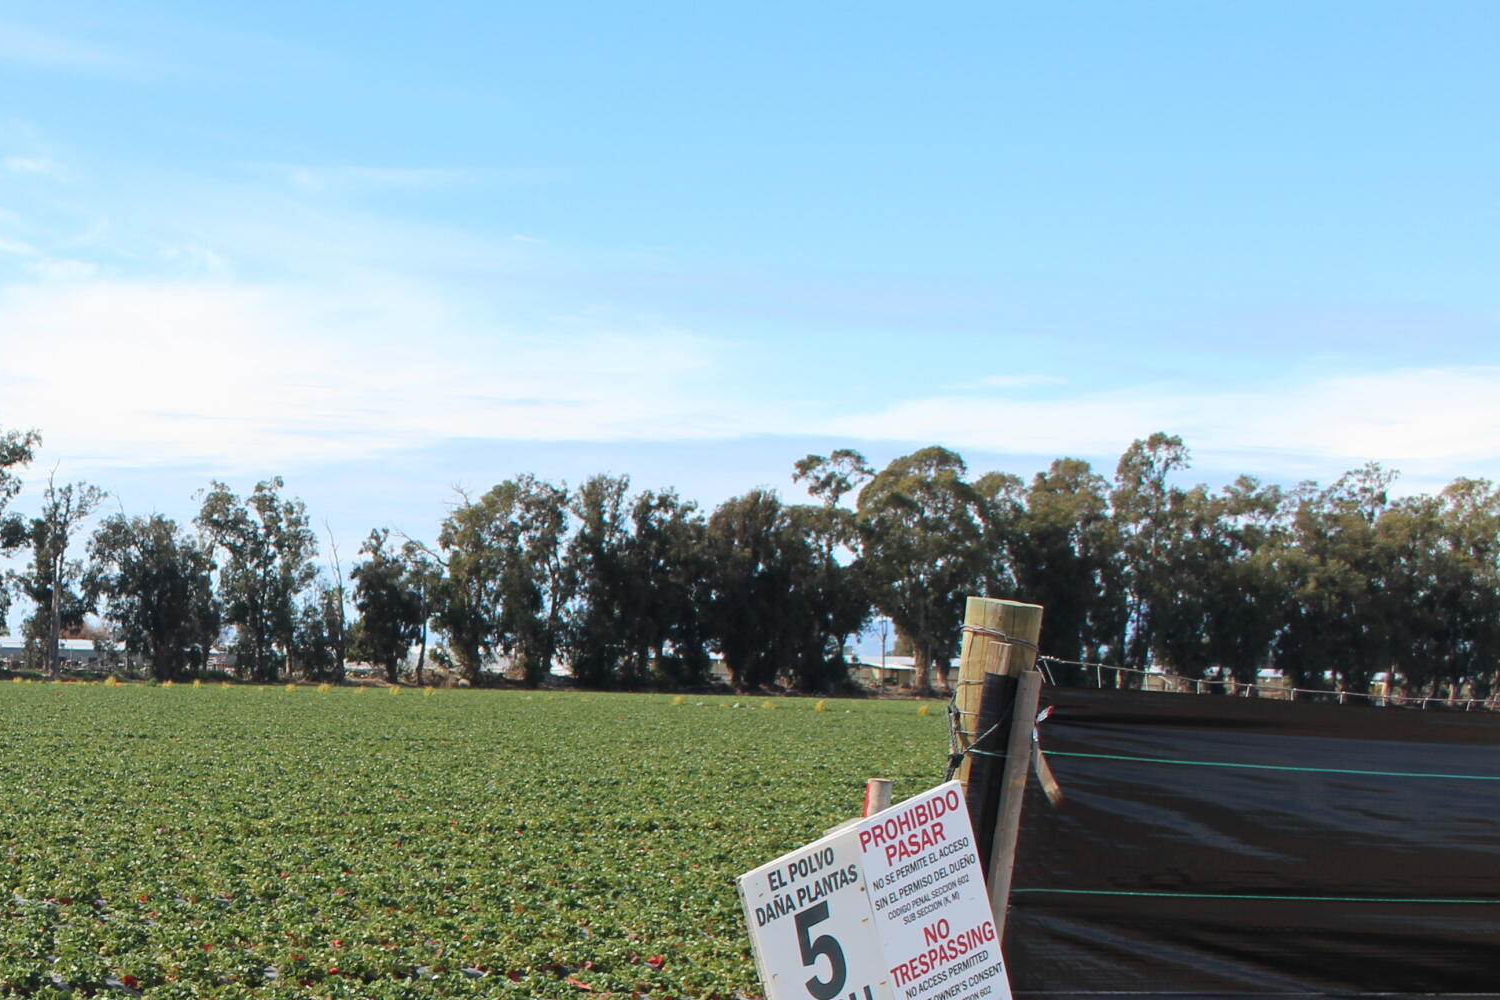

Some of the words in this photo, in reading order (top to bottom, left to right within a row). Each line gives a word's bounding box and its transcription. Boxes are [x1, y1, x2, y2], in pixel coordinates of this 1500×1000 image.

[859, 790, 959, 853] PROHIBIDO
[885, 822, 946, 867] PASAR
[767, 869, 787, 891] EL
[788, 847, 834, 882] POLVO
[872, 878, 884, 892] NO
[885, 873, 895, 886] SE
[896, 858, 928, 878] PERMITE
[929, 853, 938, 864] EL
[939, 837, 969, 858] ACCESO
[875, 897, 888, 911] SIN
[889, 892, 899, 904] EL
[899, 874, 932, 899] PERMISO
[934, 868, 949, 882] DEL
[949, 853, 976, 874] DUEÑO
[756, 894, 796, 927] DAÑA
[796, 864, 858, 907] PLANTAS
[888, 902, 912, 920] CODIGO
[912, 894, 932, 909] PENAL
[931, 882, 957, 899] SECCION
[903, 912, 916, 925] SUB
[917, 900, 943, 918] SECCION
[794, 900, 847, 1000] 5
[890, 921, 995, 988] TRESPASSING
[923, 918, 950, 947] NO
[905, 986, 917, 1000] NO
[918, 970, 948, 993] ACCESS
[948, 950, 989, 978] PERMITTED
[968, 962, 1002, 988] CONSENT
